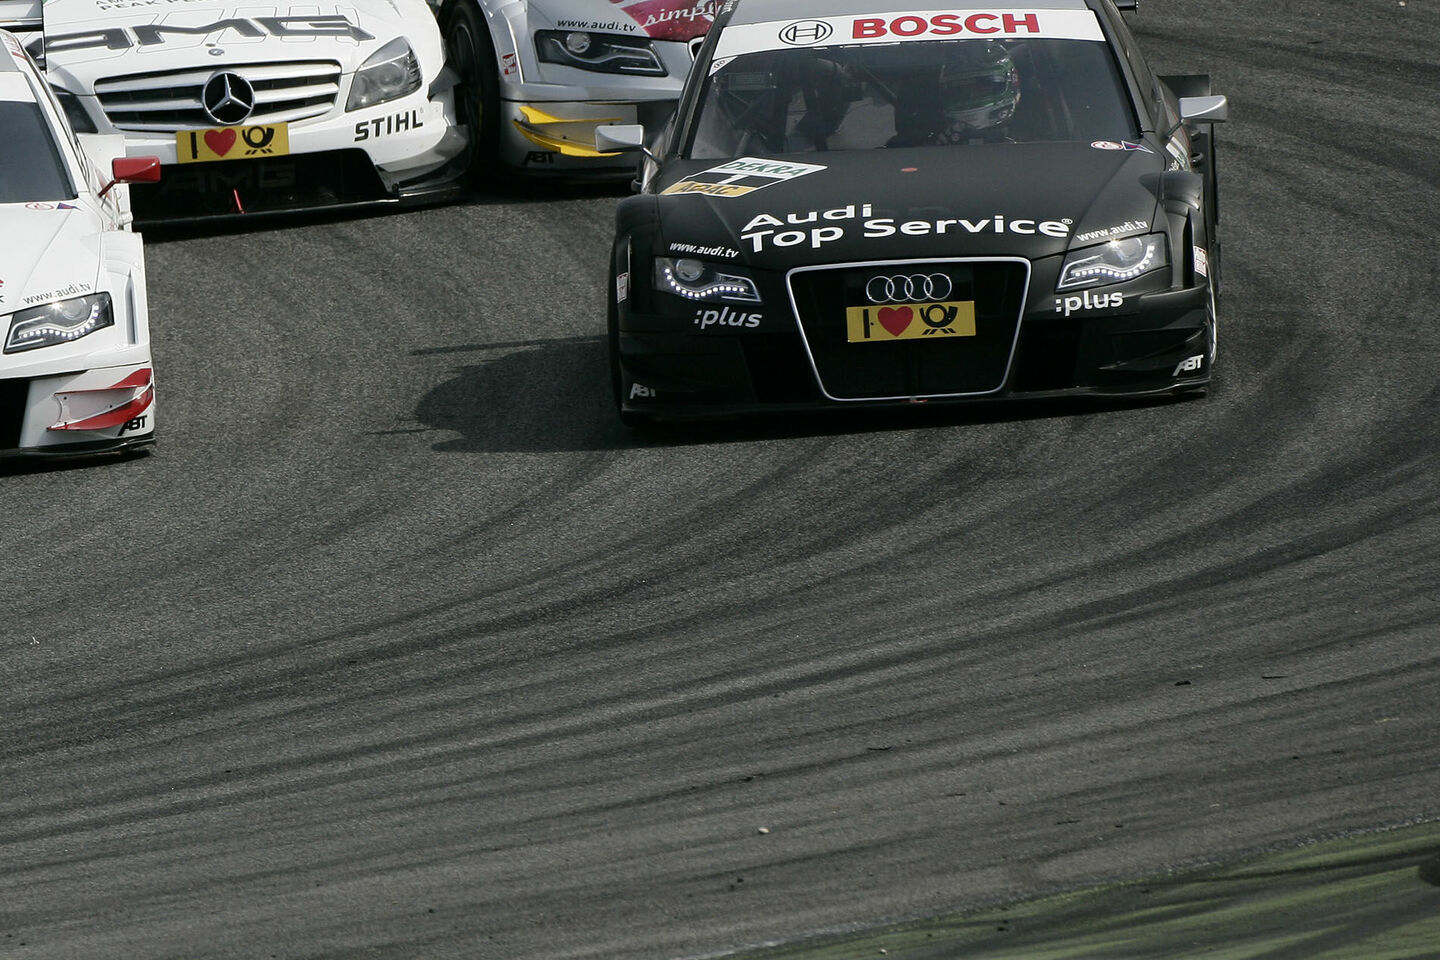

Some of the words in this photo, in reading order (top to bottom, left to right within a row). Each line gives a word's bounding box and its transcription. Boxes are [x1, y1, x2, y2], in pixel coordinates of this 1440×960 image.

[100, 0, 163, 12] PEAK
[23, 15, 376, 59] AMG
[556, 18, 637, 32] www.audi.tv
[852, 14, 1040, 40] BOSCH
[354, 110, 424, 142] STIHL
[523, 150, 557, 166] ABT
[720, 161, 809, 177] DEKRA
[677, 181, 739, 195] ADAC
[741, 203, 872, 232] Audi
[741, 225, 844, 253] Top
[1076, 218, 1149, 242] www.audi.tv
[669, 242, 740, 259] www.audi.tv
[22, 281, 92, 305] www.audi.tv
[1055, 290, 1124, 317] :plus
[693, 306, 763, 330] :plus
[1172, 354, 1204, 377] ABT
[117, 414, 148, 437] ABT
